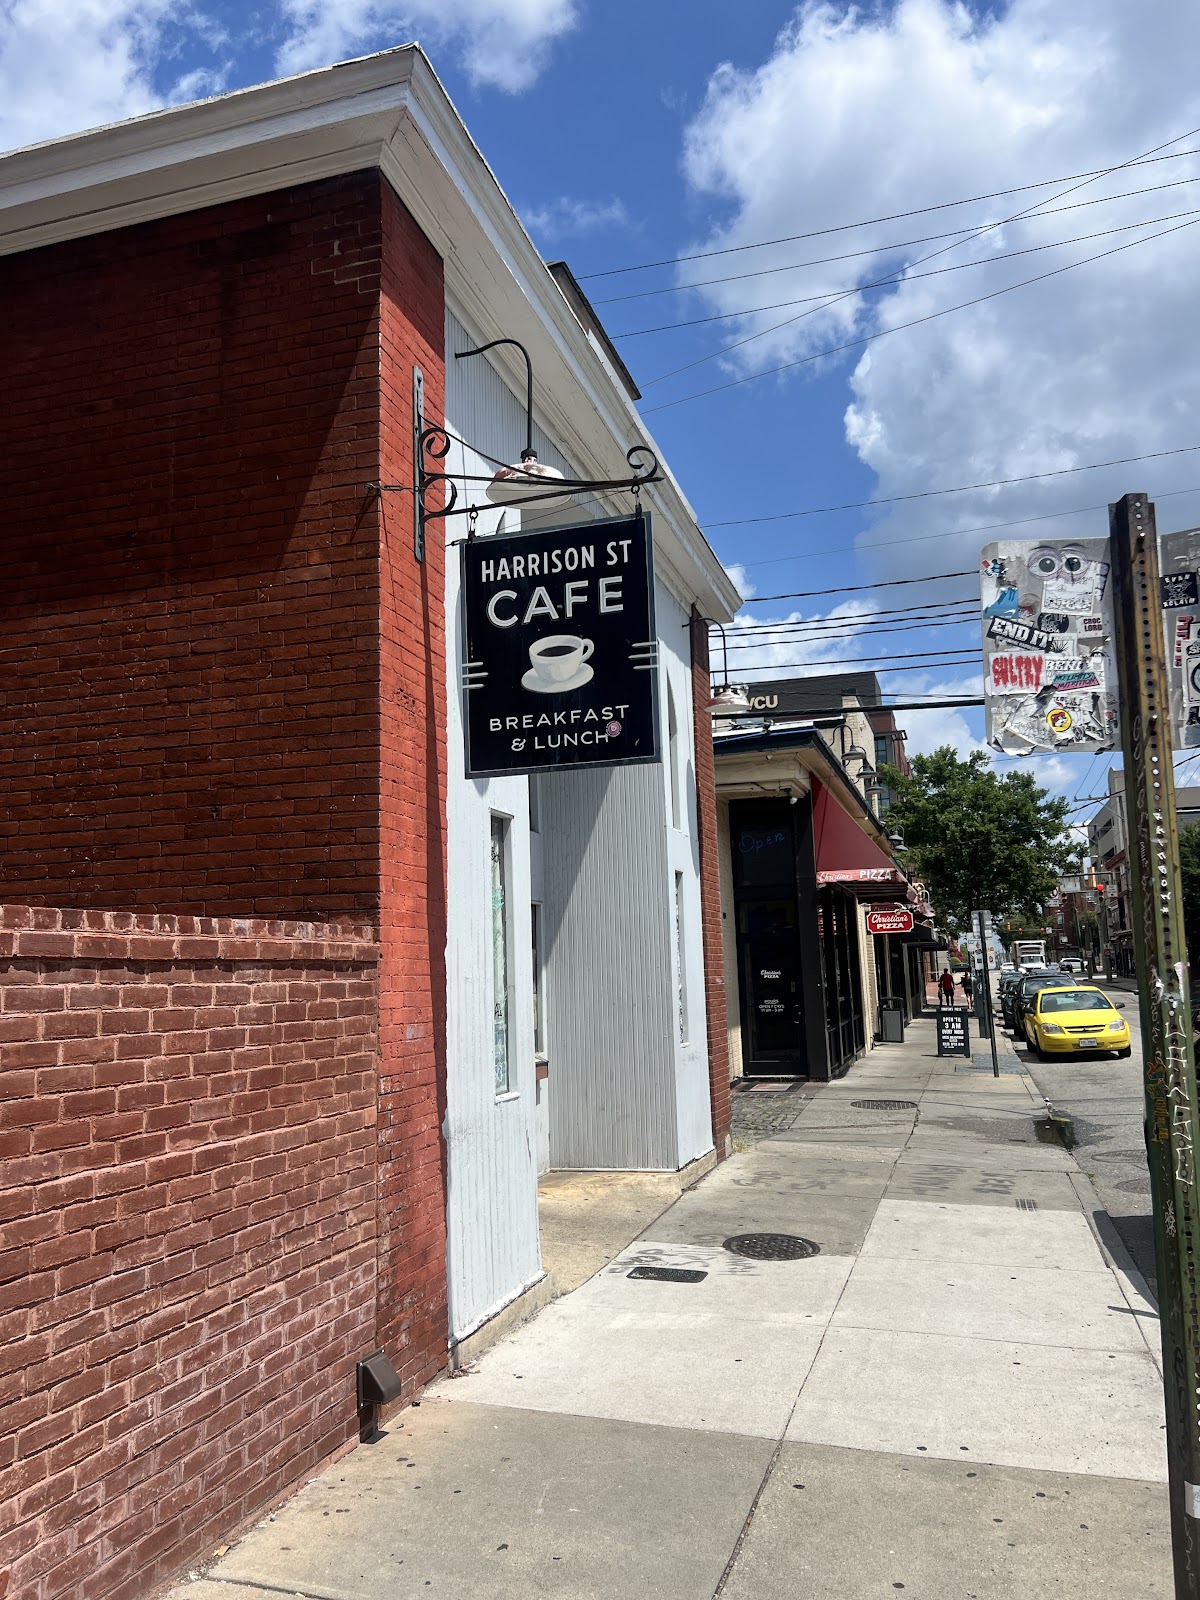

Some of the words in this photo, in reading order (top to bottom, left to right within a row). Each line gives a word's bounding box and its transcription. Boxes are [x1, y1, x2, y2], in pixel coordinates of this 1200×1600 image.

[481, 545, 595, 583] HARRISON
[606, 539, 632, 566] ST
[487, 575, 624, 629] CAFE
[990, 616, 1030, 642] END
[489, 704, 629, 732] BREAKFAST
[511, 738, 526, 752] &
[534, 730, 609, 750] LUNCH
[859, 869, 892, 880] PIZZA
[871, 913, 909, 923] Christian's
[876, 922, 904, 930] PIZZA
